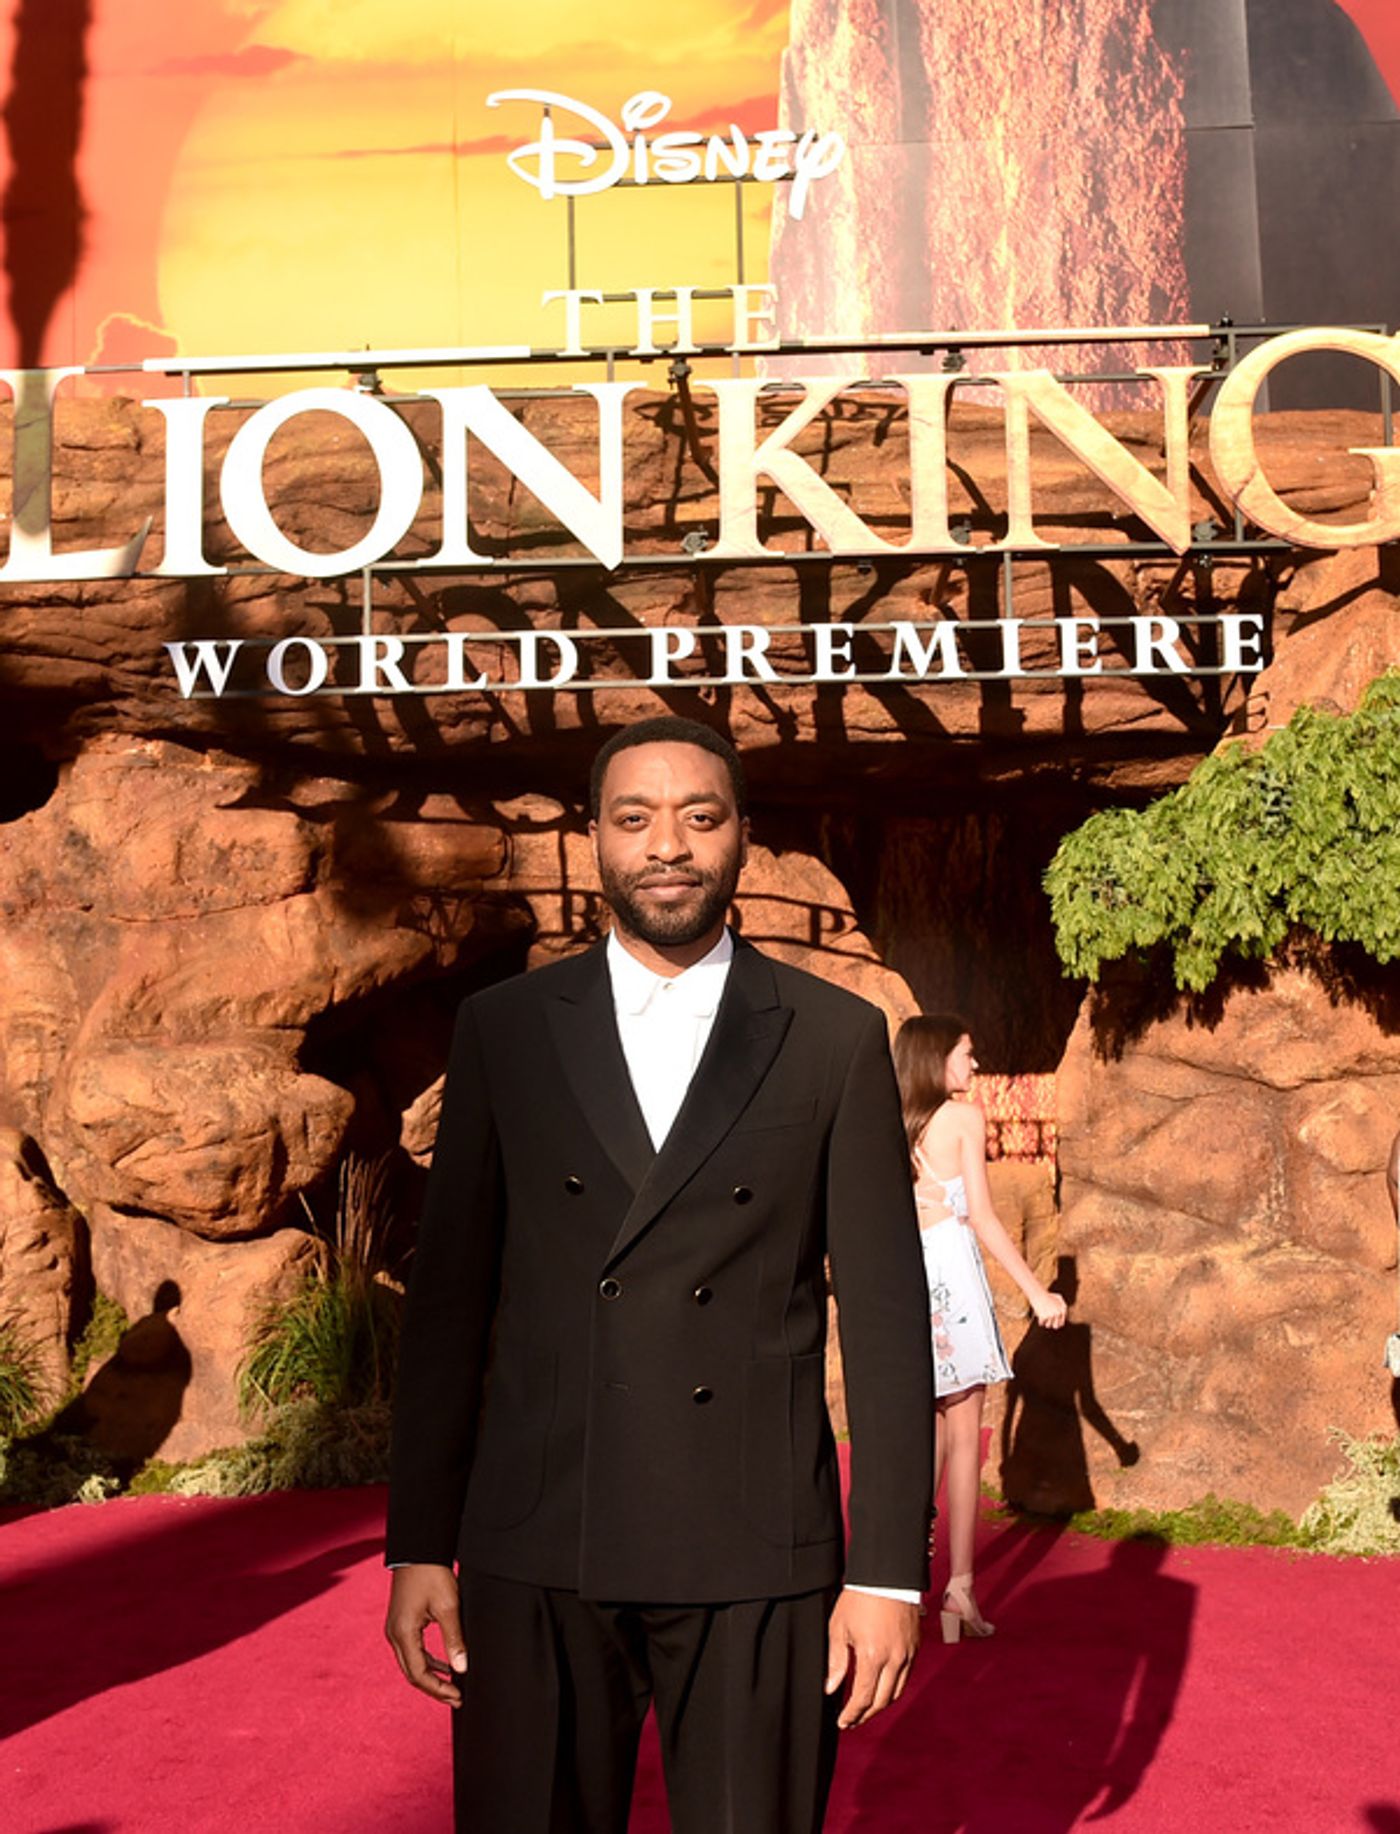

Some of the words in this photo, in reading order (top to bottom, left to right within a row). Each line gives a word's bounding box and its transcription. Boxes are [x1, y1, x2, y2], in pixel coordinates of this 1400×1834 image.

[541, 284, 780, 357] THE
[0, 368, 648, 580] LION
[693, 326, 1400, 557] KING
[165, 629, 578, 699] WORLD
[649, 612, 1266, 685] PREMIERE
